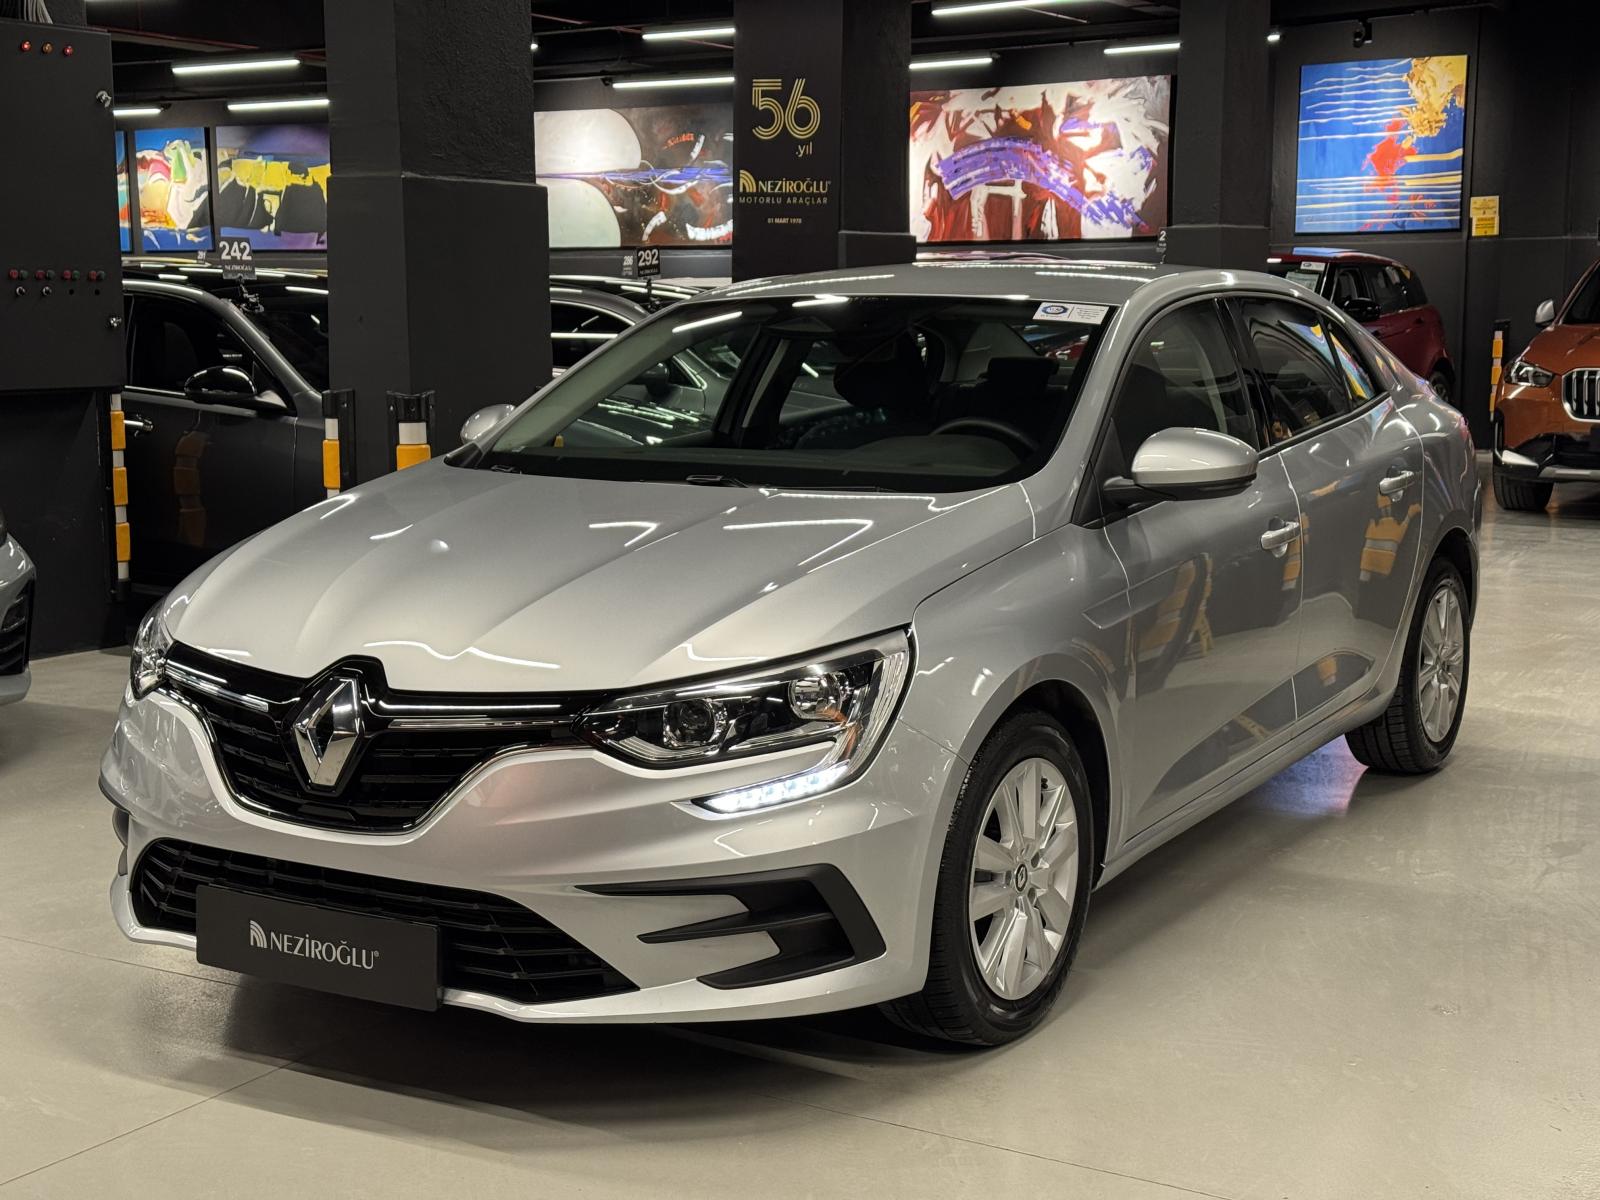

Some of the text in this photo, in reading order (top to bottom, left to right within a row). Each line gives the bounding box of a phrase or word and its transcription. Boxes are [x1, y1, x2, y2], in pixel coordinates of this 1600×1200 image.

[752, 78, 821, 139] 56
[739, 196, 828, 206] MOTORLU ARAÇLAR
[219, 240, 252, 260] 242
[638, 249, 659, 266] 292
